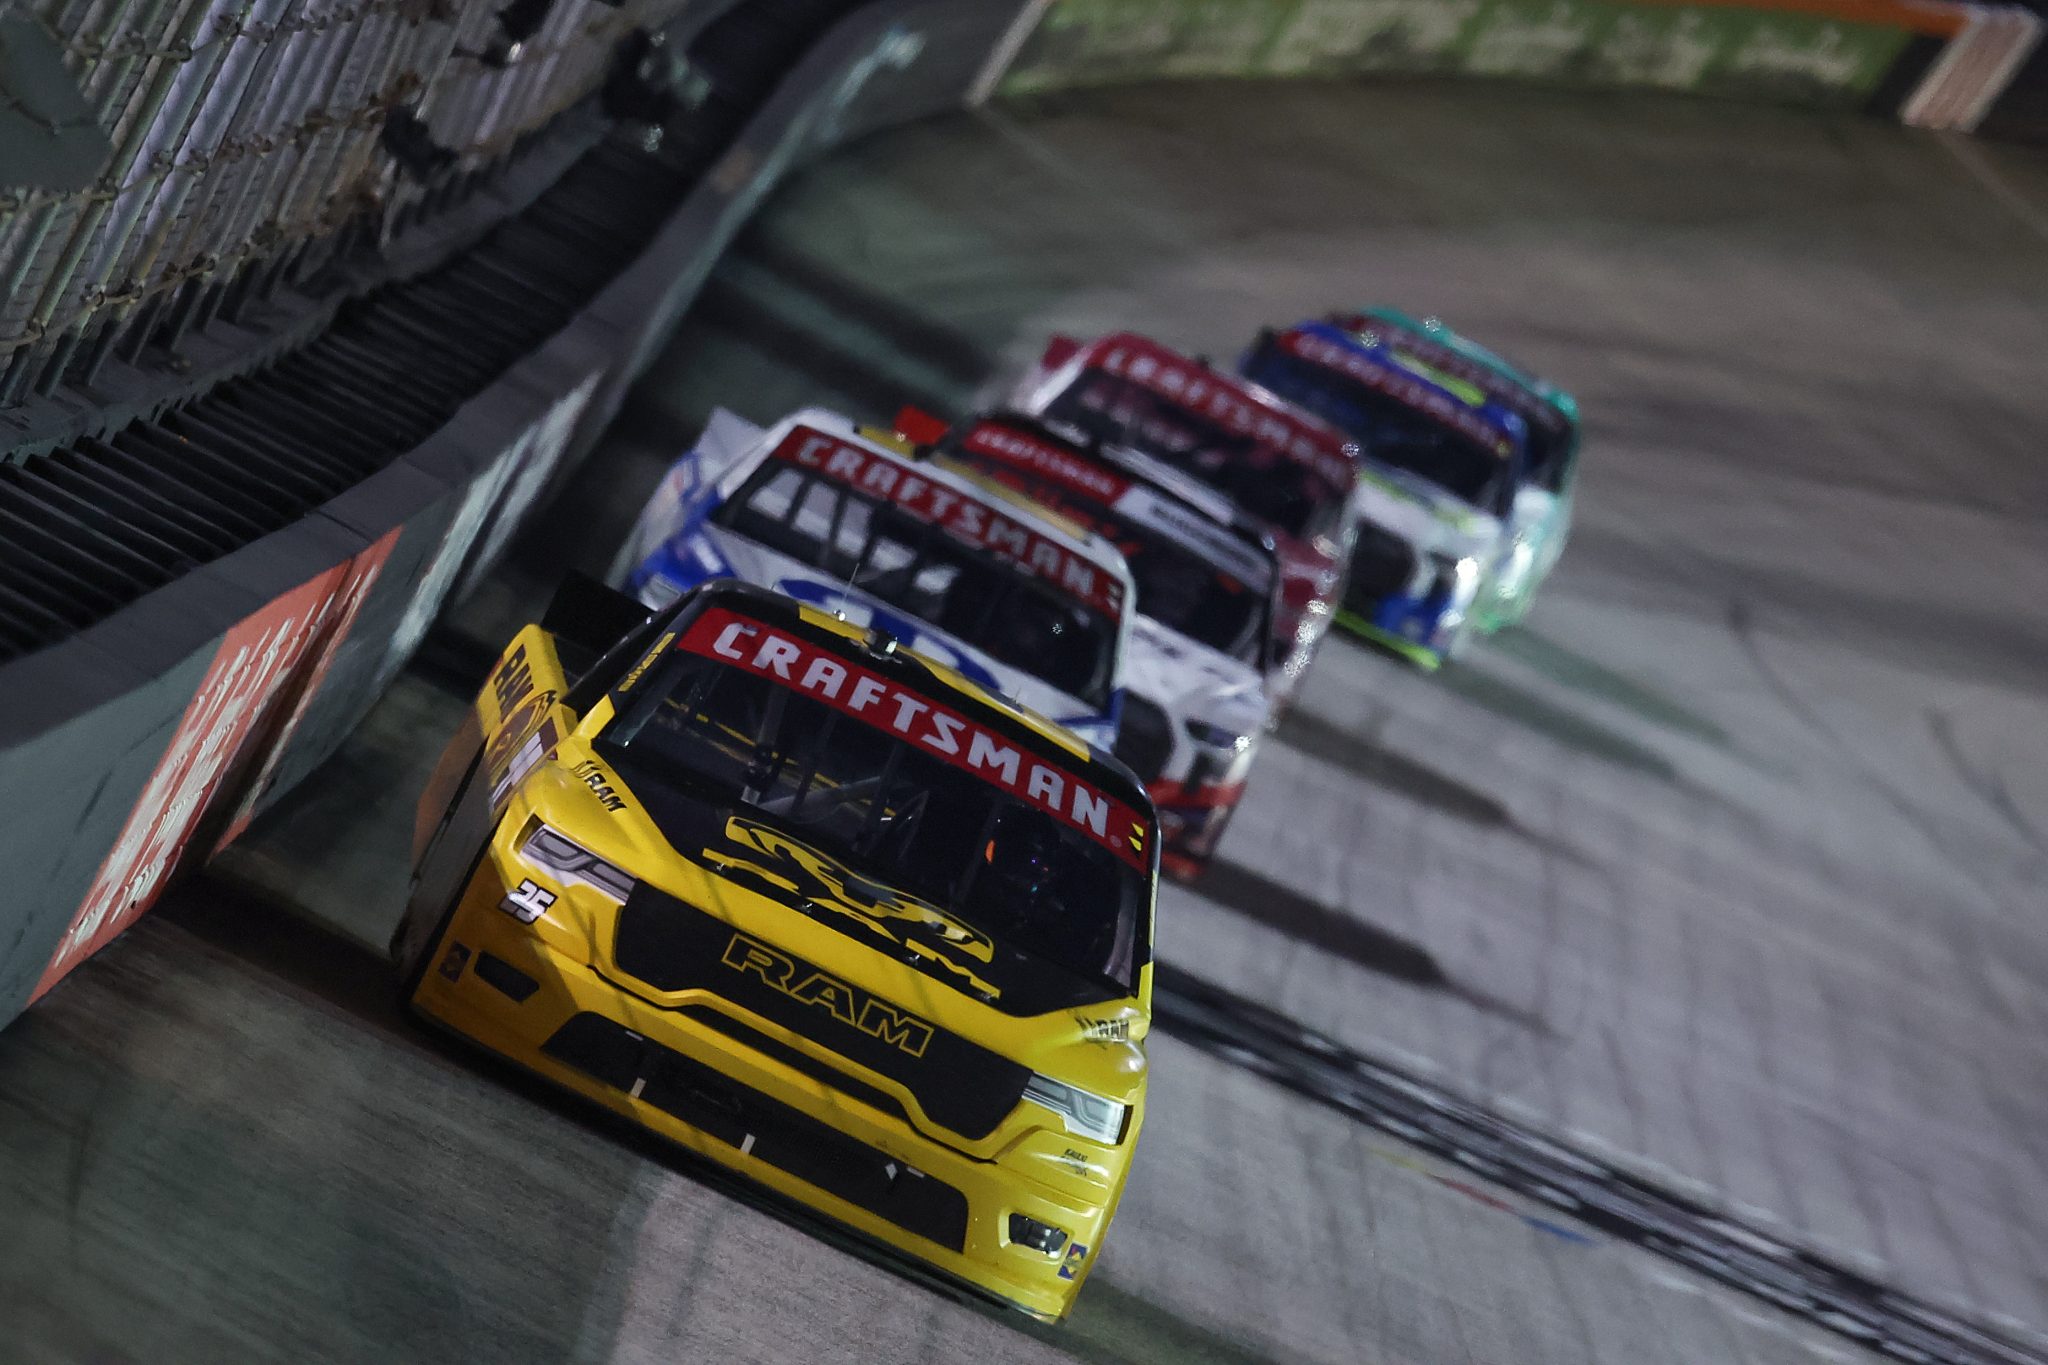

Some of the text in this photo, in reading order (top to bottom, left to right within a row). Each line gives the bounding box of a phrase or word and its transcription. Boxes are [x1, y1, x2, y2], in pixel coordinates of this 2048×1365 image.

[799, 436, 1096, 594] CRAFTSMAN
[713, 621, 1109, 838] CRAFTSMAN
[583, 773, 627, 812] RAM
[497, 877, 558, 925] 25
[721, 933, 935, 1058] RAM
